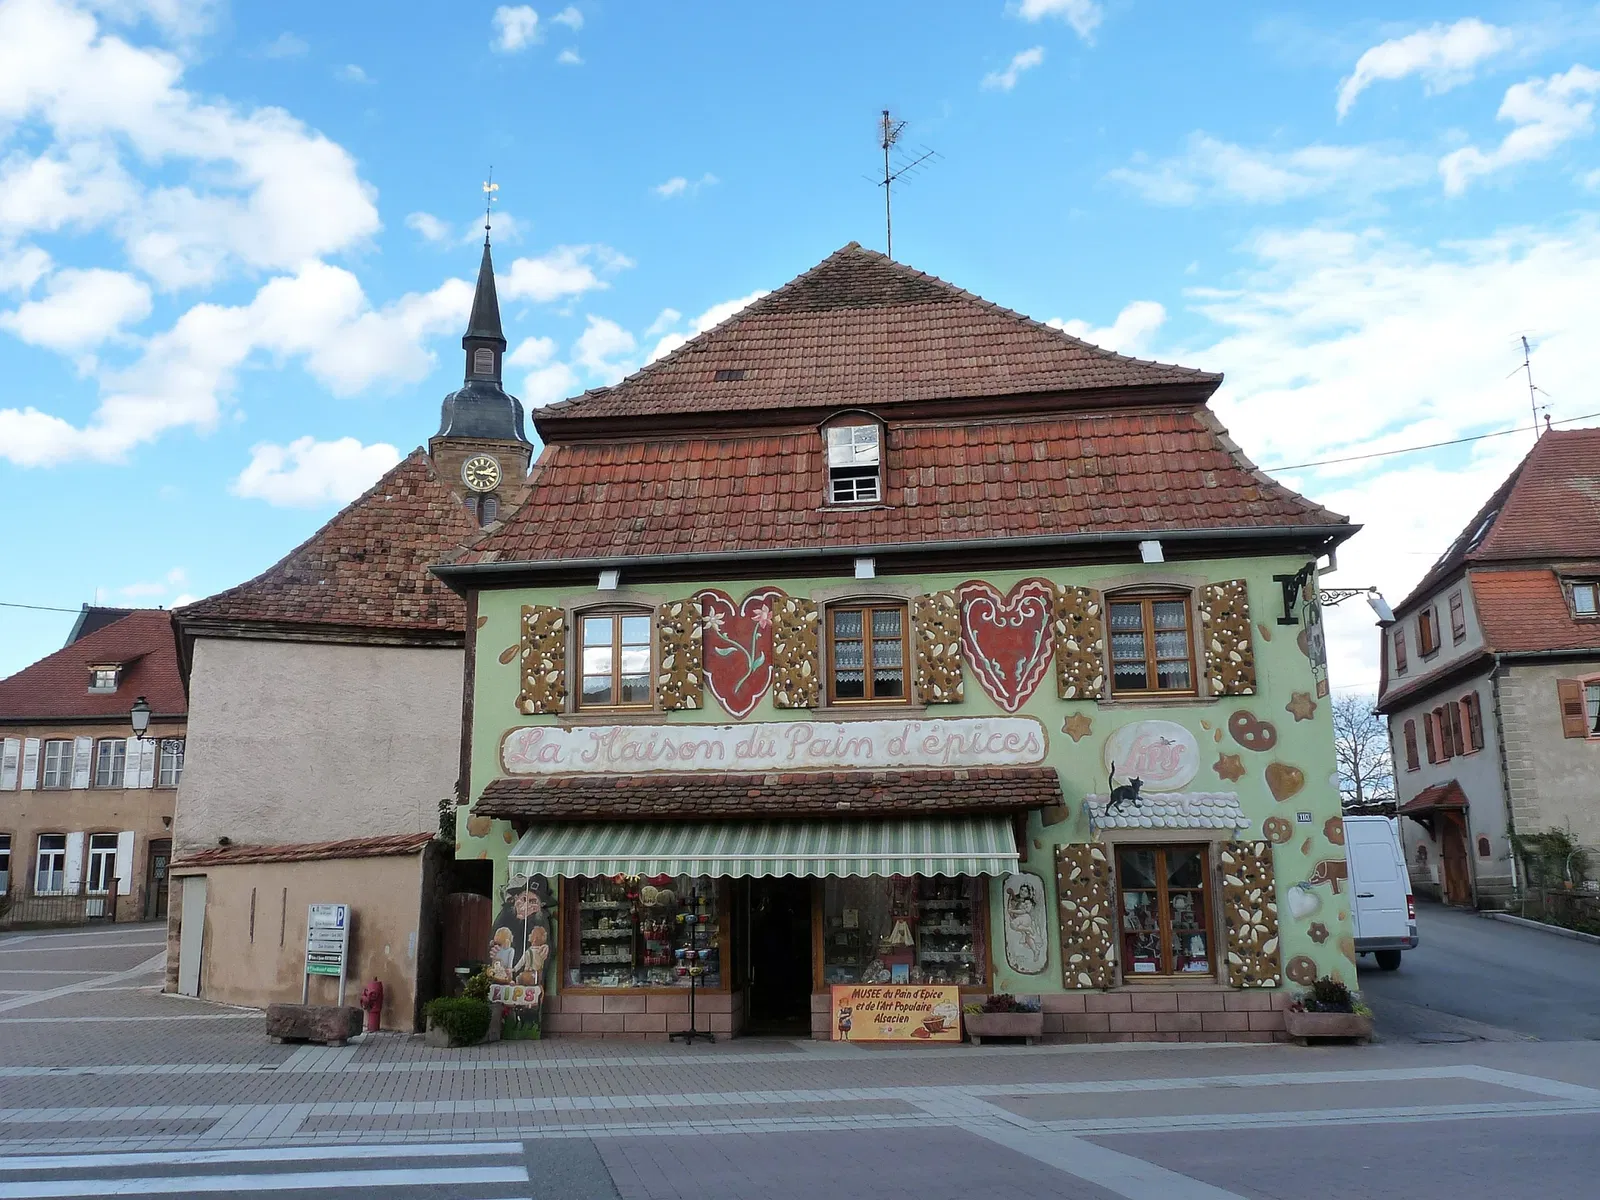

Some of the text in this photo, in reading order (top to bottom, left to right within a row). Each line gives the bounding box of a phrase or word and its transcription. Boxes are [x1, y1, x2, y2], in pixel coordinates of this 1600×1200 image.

[509, 723, 1040, 764] La Maison du Pain d'épices
[337, 907, 344, 926] P
[852, 988, 882, 999] MUSEE
[883, 989, 893, 999] du
[895, 988, 912, 999] Pain
[856, 1002, 865, 1011] et
[865, 1001, 876, 1011] de
[895, 1001, 932, 1013] Populaire
[874, 1012, 910, 1024] Alsacien
